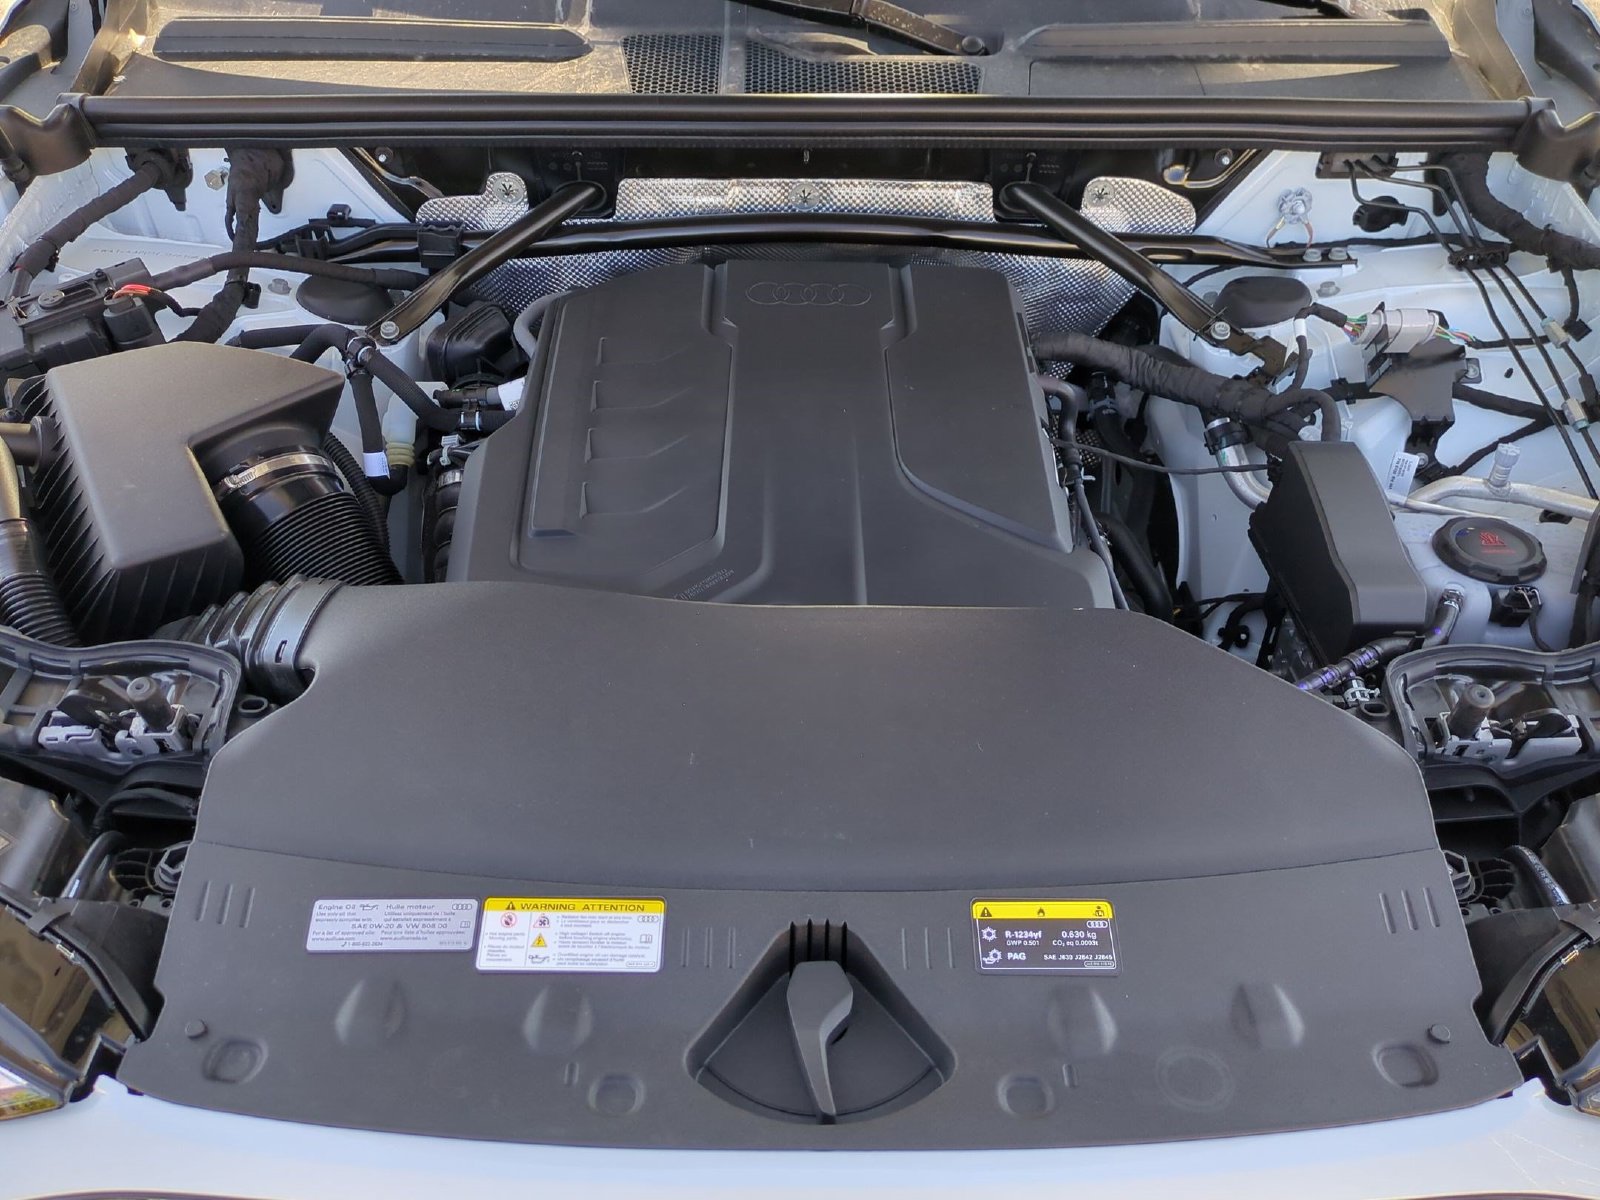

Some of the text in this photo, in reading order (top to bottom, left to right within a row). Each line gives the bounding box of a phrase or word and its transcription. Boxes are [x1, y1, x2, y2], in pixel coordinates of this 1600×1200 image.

[582, 904, 645, 912] ATTENTION
[1005, 930, 1042, 939] R-1234yf
[1062, 930, 1097, 940] 0.630 kg
[1007, 952, 1026, 960] PAG
